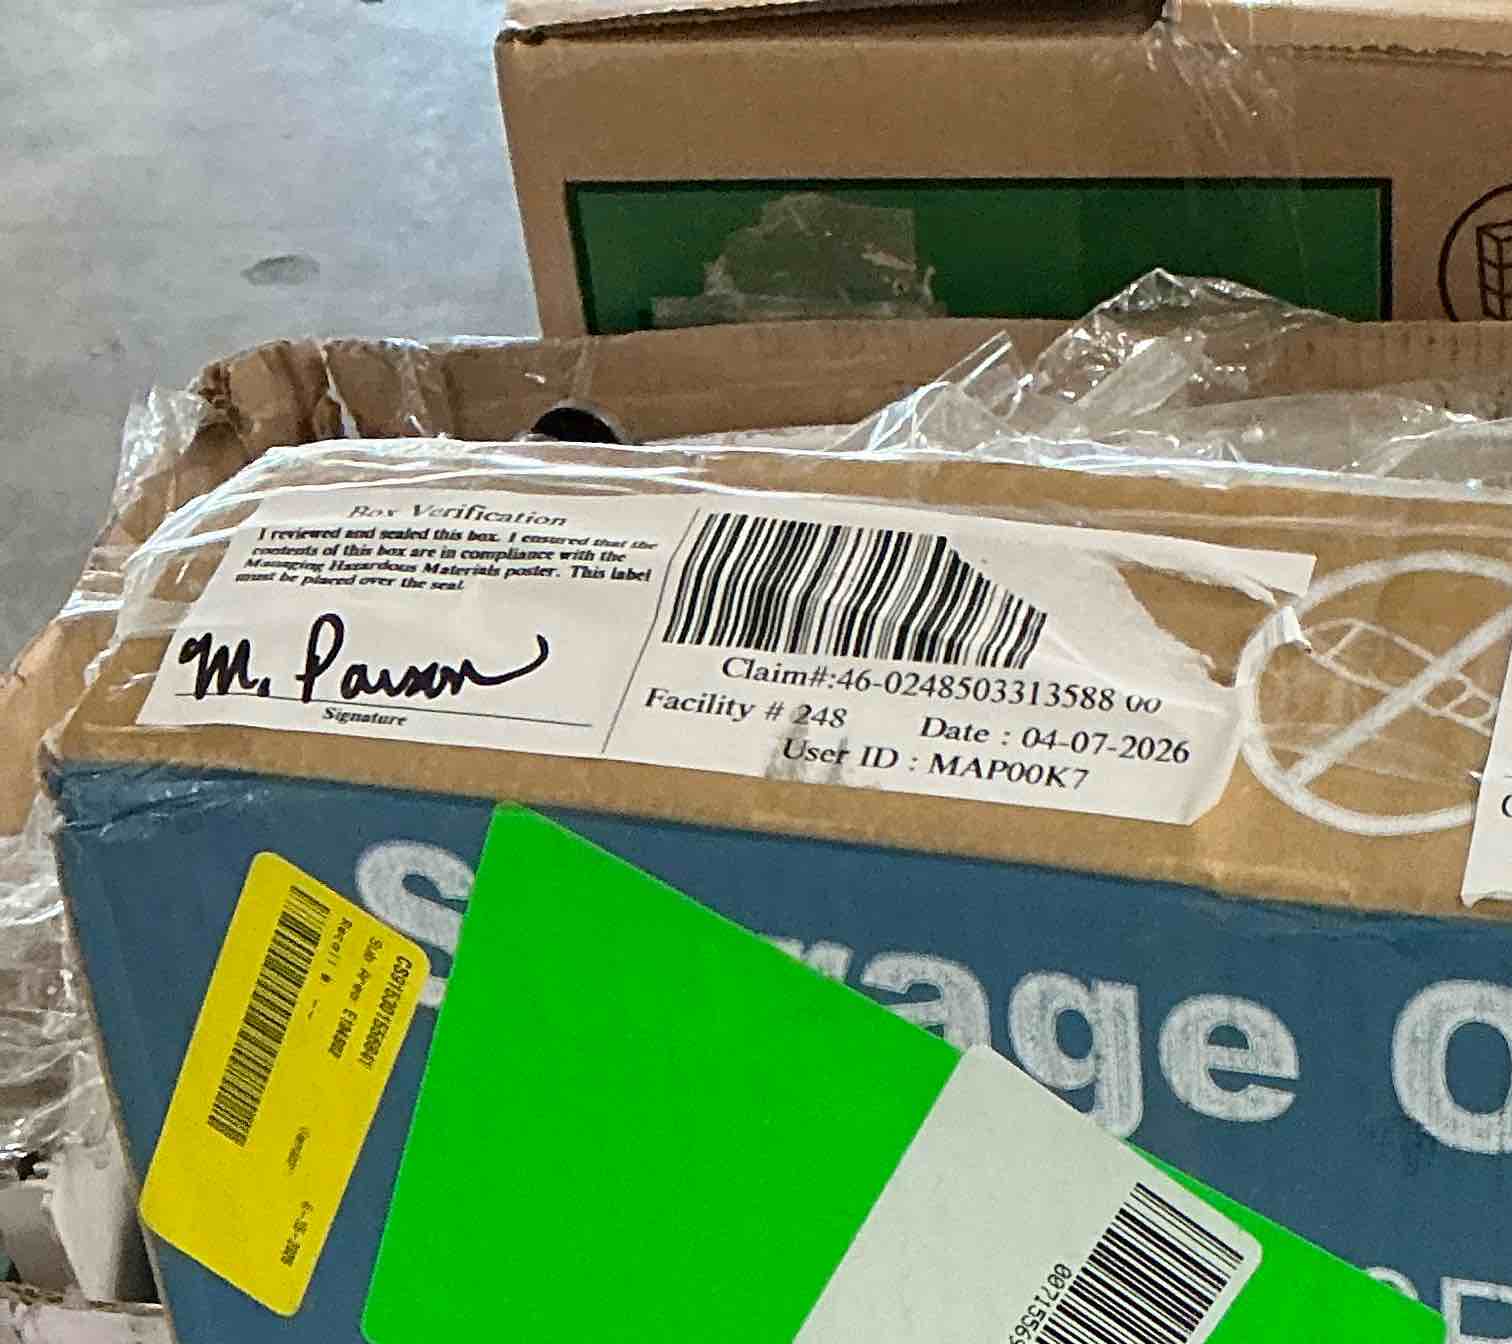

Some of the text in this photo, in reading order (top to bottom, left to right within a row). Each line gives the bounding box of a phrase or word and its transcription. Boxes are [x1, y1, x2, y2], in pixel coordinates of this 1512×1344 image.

[412, 503, 568, 527] Verification
[258, 527, 266, 540] I
[271, 528, 340, 540] reviewed
[344, 528, 375, 539] and
[379, 528, 433, 540] sealed
[433, 527, 462, 541] this
[521, 534, 590, 546] ensured
[593, 538, 627, 548] that
[632, 541, 658, 550] the
[252, 544, 626, 563] contents of this box are in compliance with the
[235, 572, 426, 589] must be placed over the
[244, 559, 652, 582] Managing Hazardous Materials poster. This label
[321, 705, 407, 727] Signature
[644, 687, 848, 730] Facility # 248
[919, 717, 1191, 765] Date 04-07-2026
[782, 738, 850, 766] User
[860, 745, 899, 770] ID
[355, 840, 1302, 1138] Sage
